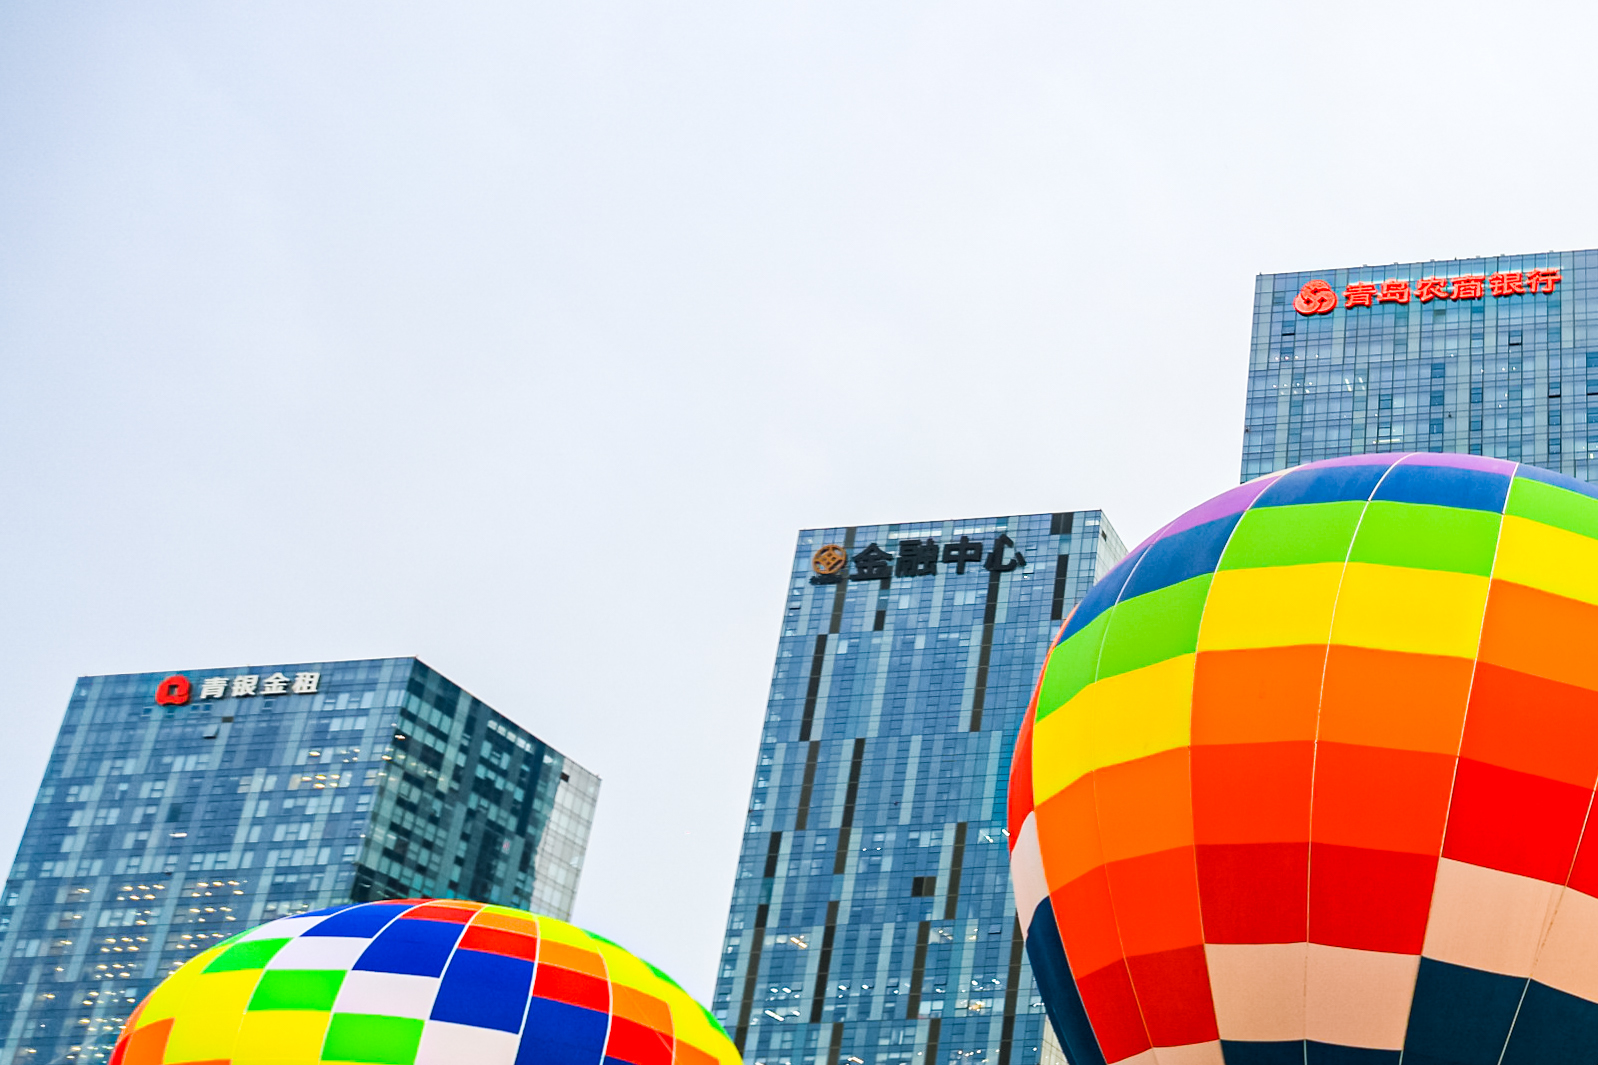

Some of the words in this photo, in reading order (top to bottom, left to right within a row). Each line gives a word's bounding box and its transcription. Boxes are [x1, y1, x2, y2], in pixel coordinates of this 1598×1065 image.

[1343, 268, 1562, 309] 青岛农商银行
[850, 534, 1027, 582] 金融中心
[200, 672, 320, 699] 青银金租
